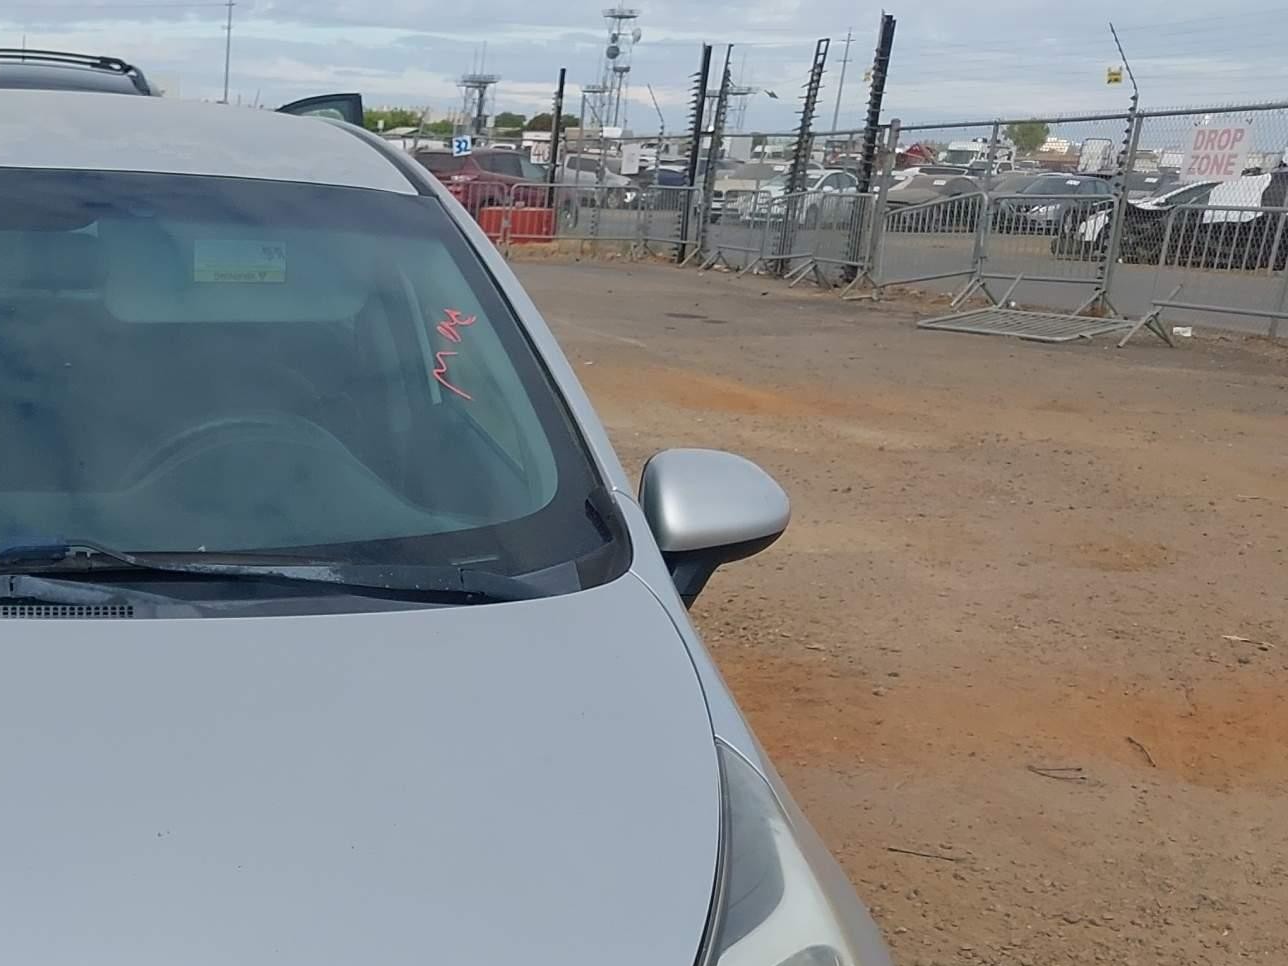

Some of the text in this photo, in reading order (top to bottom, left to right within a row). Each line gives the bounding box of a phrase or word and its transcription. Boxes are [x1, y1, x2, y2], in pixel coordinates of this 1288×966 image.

[454, 139, 471, 154] 32
[1192, 128, 1245, 151] DROP
[1186, 153, 1238, 176] ZONE
